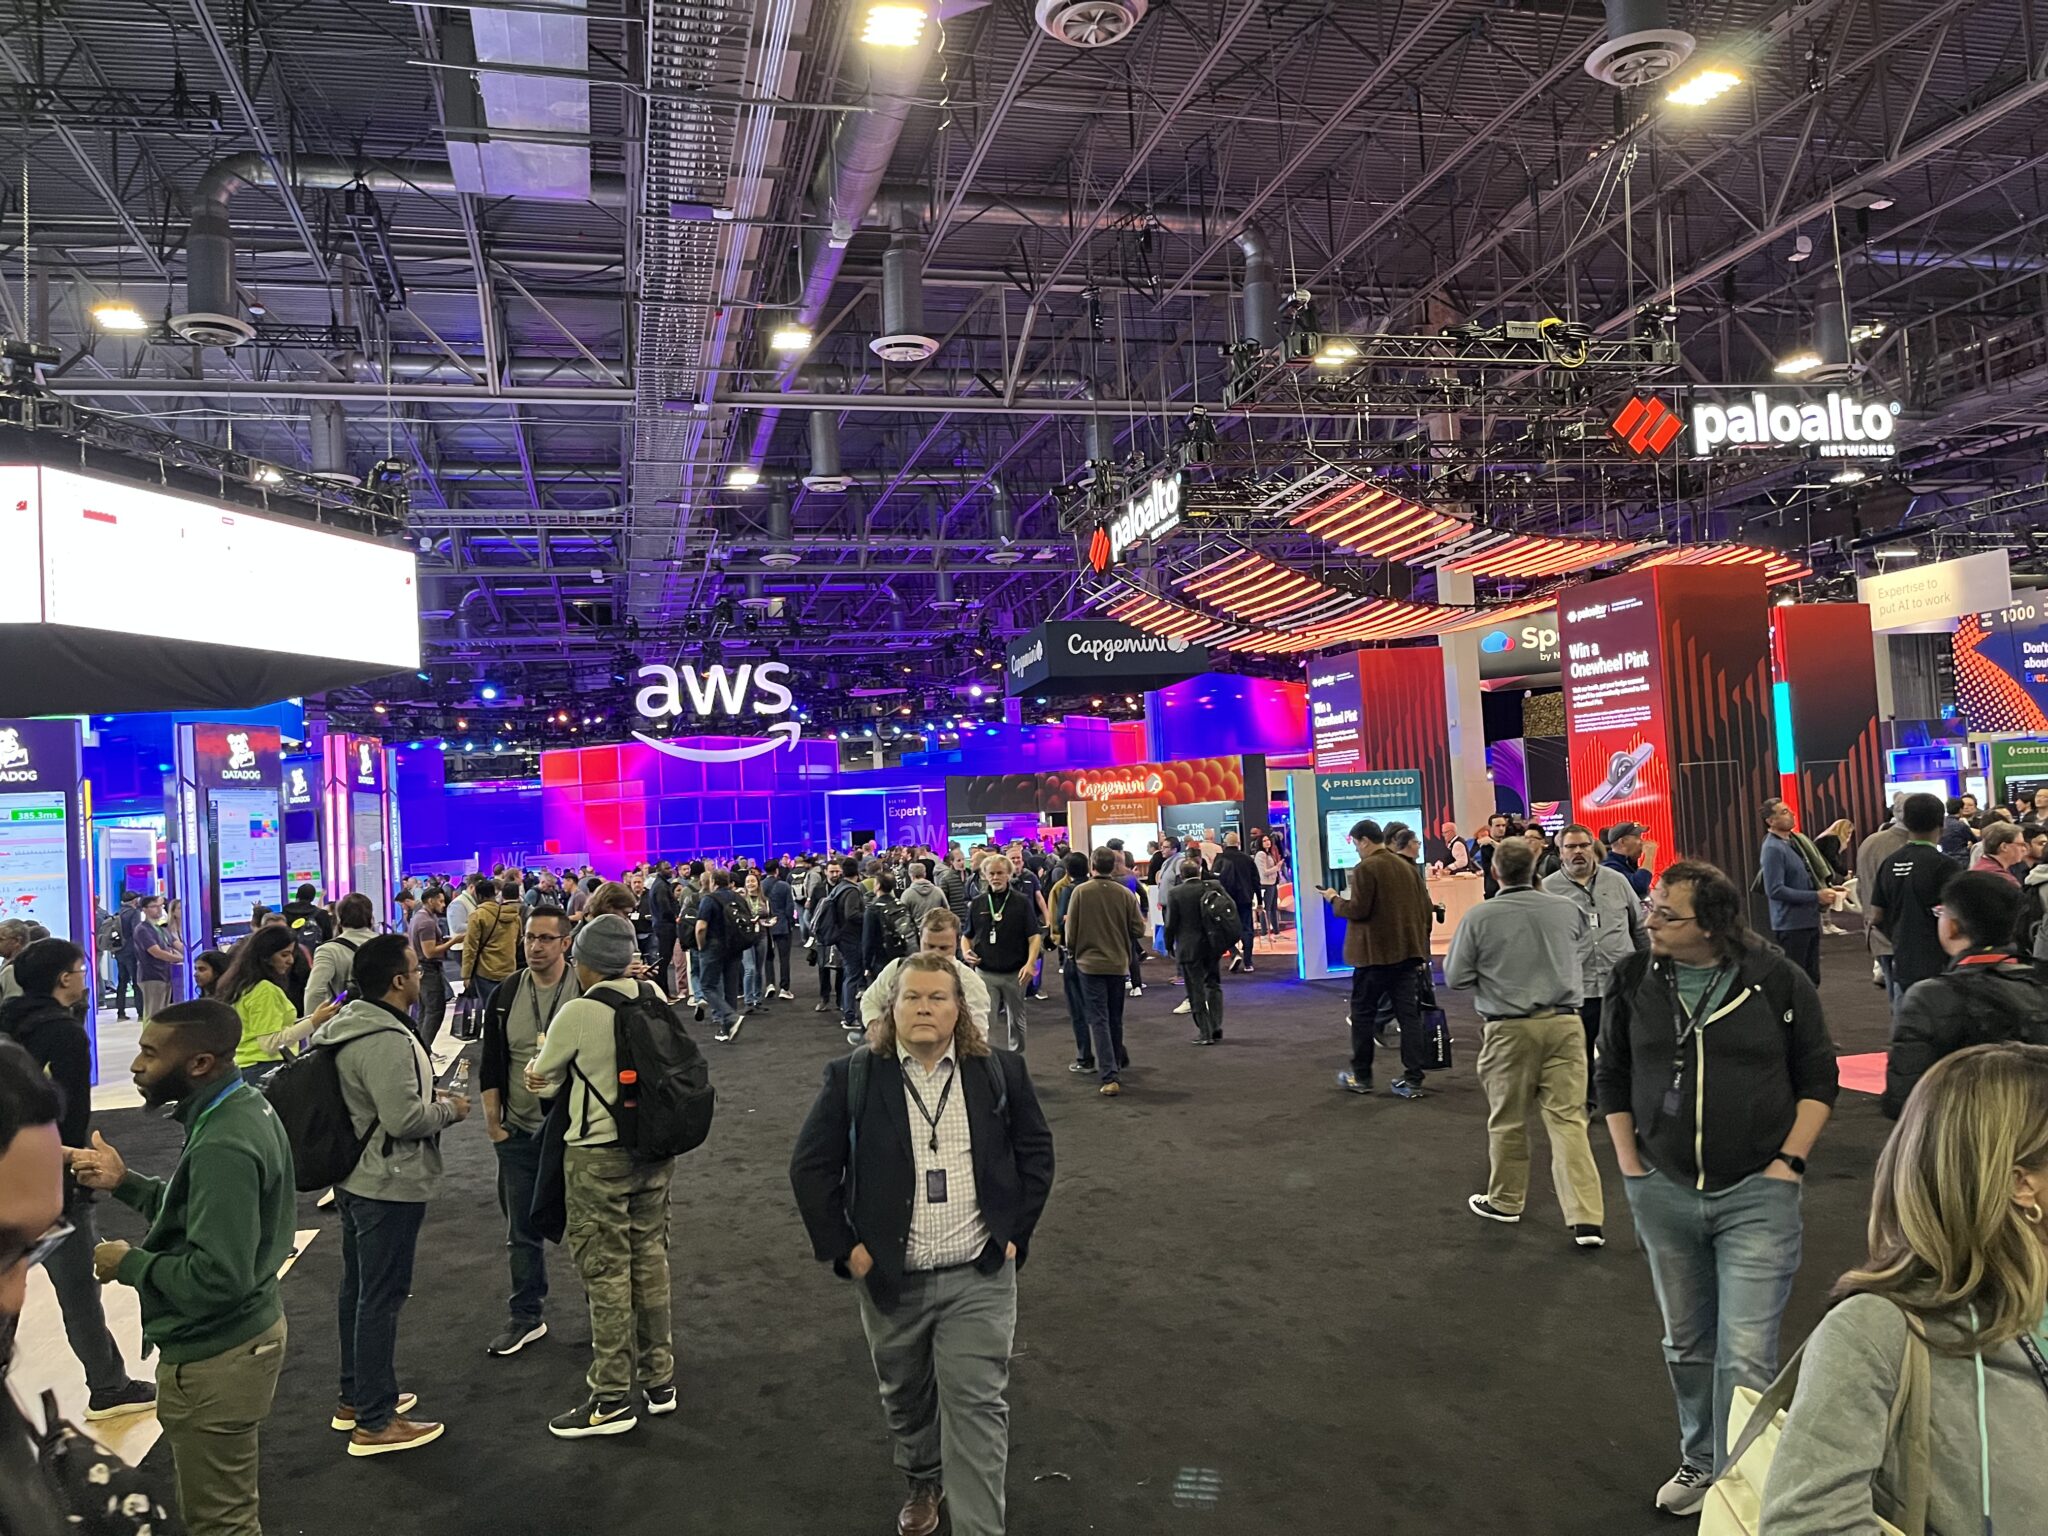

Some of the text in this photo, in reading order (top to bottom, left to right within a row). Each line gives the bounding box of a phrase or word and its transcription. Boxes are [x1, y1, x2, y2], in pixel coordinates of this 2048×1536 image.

[1820, 445, 1896, 457] NETWORKS
[1878, 579, 1938, 599] Expertise to
[1880, 592, 1951, 616] put AI to work
[2000, 605, 2035, 623] 1000
[1067, 633, 1168, 662] Capgemini
[1521, 627, 1560, 651] Sp
[2023, 641, 2048, 654] Don't
[1540, 652, 1551, 661] by
[1568, 642, 1599, 660] Win a
[1011, 644, 1038, 678] Capgemini
[1570, 651, 1650, 678] Onewheel Pint
[635, 662, 793, 717] aws
[0, 770, 38, 782] ADOG
[222, 770, 261, 779] DATADOG
[1383, 777, 1414, 785] CLOUD
[1076, 775, 1146, 800] Capgemini
[18, 812, 58, 820] 385.3ms
[888, 806, 927, 819] Experts
[898, 824, 946, 850] aw
